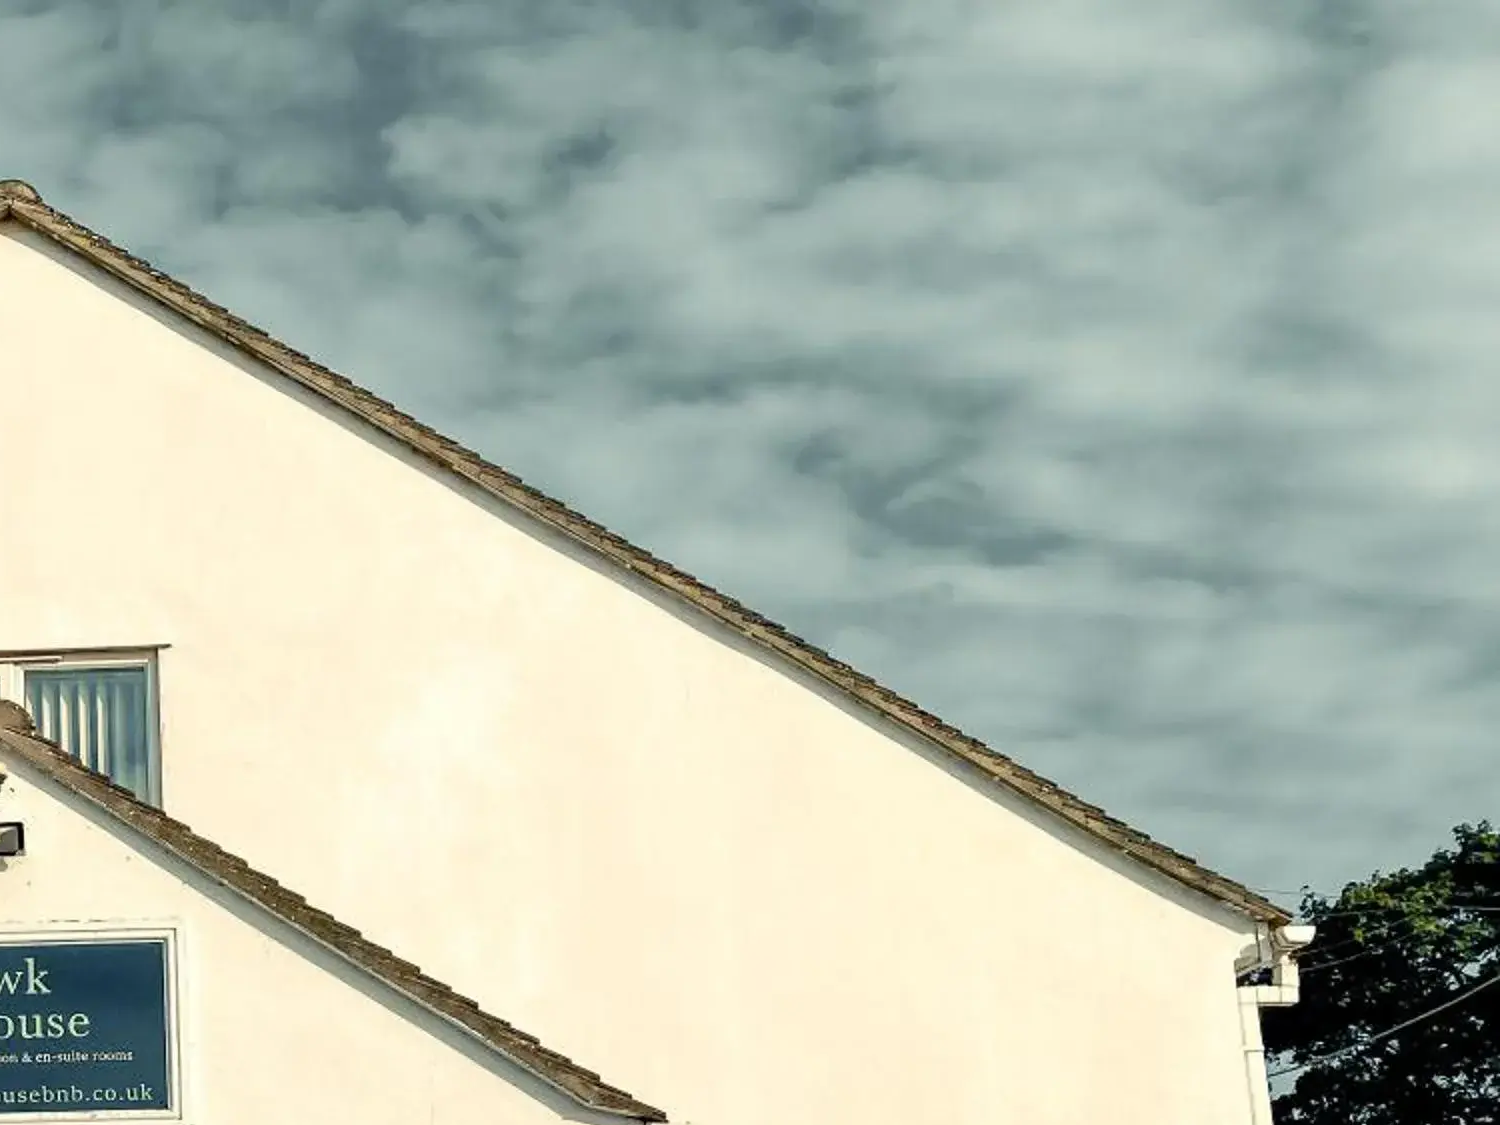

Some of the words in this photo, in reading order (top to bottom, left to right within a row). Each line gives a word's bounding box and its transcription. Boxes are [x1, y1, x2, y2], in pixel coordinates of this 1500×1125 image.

[22, 1053, 33, 1063] &
[36, 1051, 89, 1063] en-suite
[93, 1050, 133, 1061] rooms
